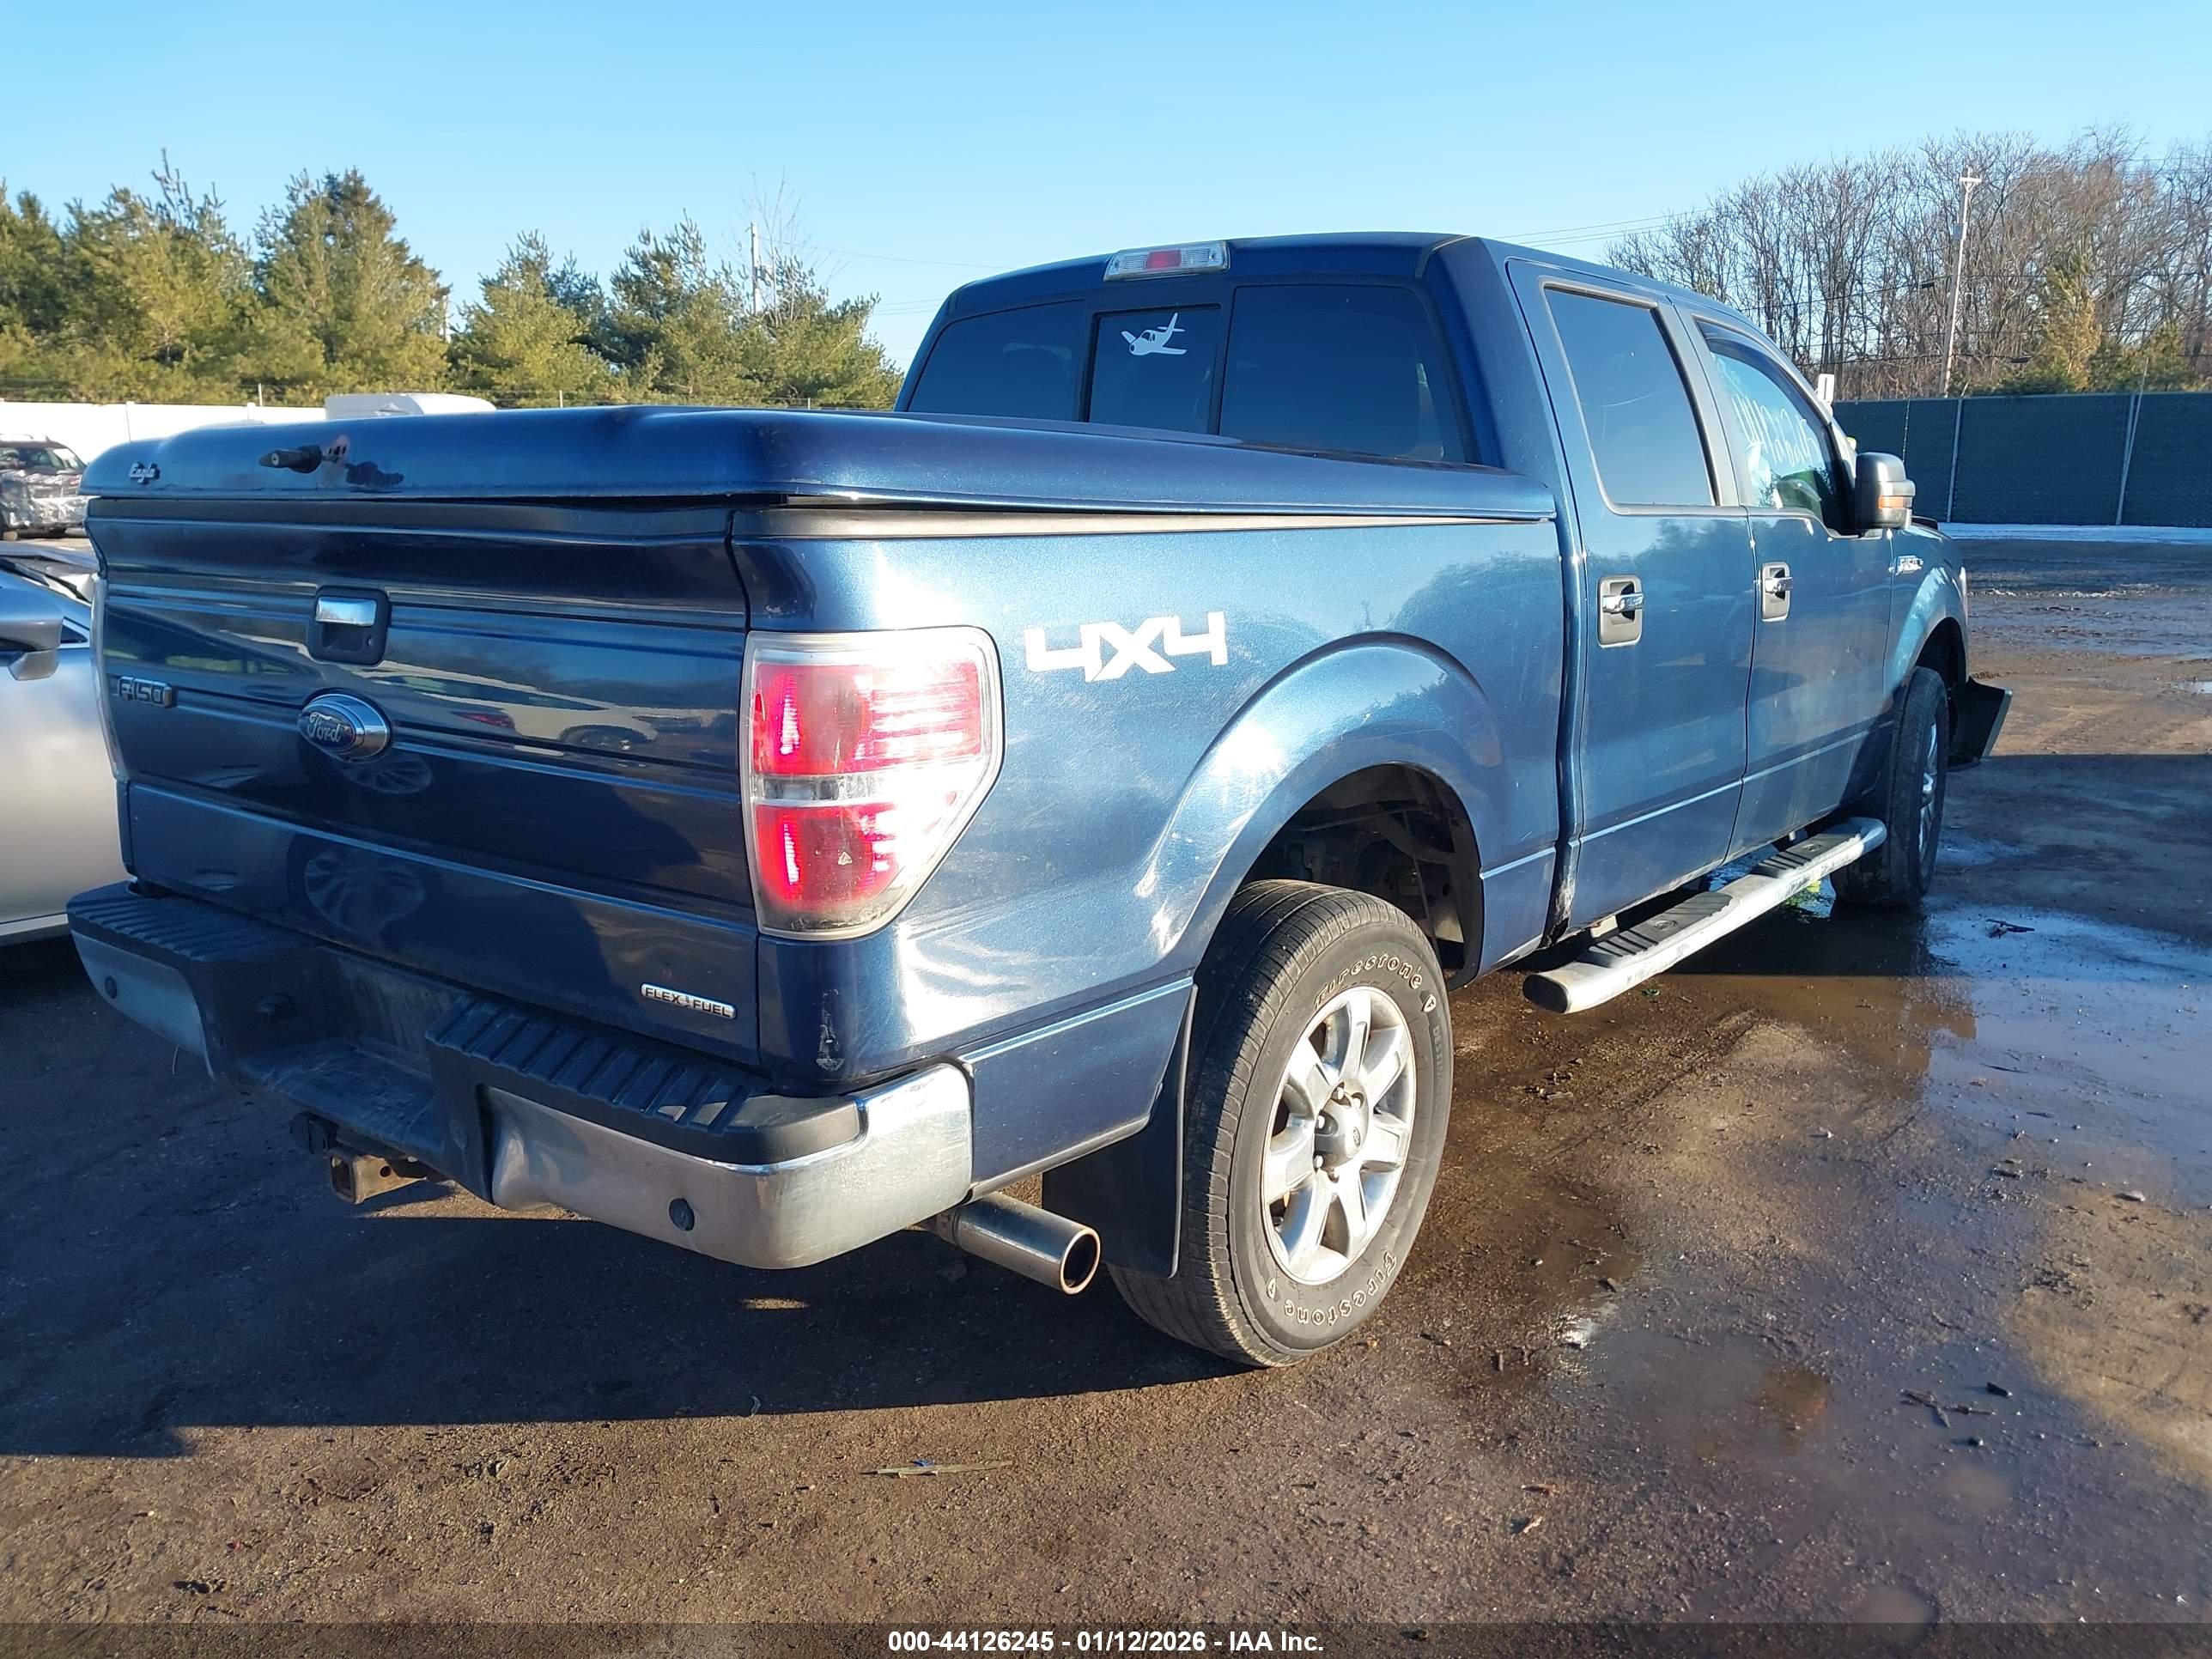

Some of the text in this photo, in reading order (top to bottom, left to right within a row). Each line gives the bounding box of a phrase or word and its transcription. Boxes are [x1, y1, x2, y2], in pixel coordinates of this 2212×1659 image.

[307, 712, 342, 742] Ford
[645, 986, 732, 1018] FLEX FUEL
[1313, 951, 1423, 1010] Firestone
[1285, 1251, 1397, 1326] Firestone
